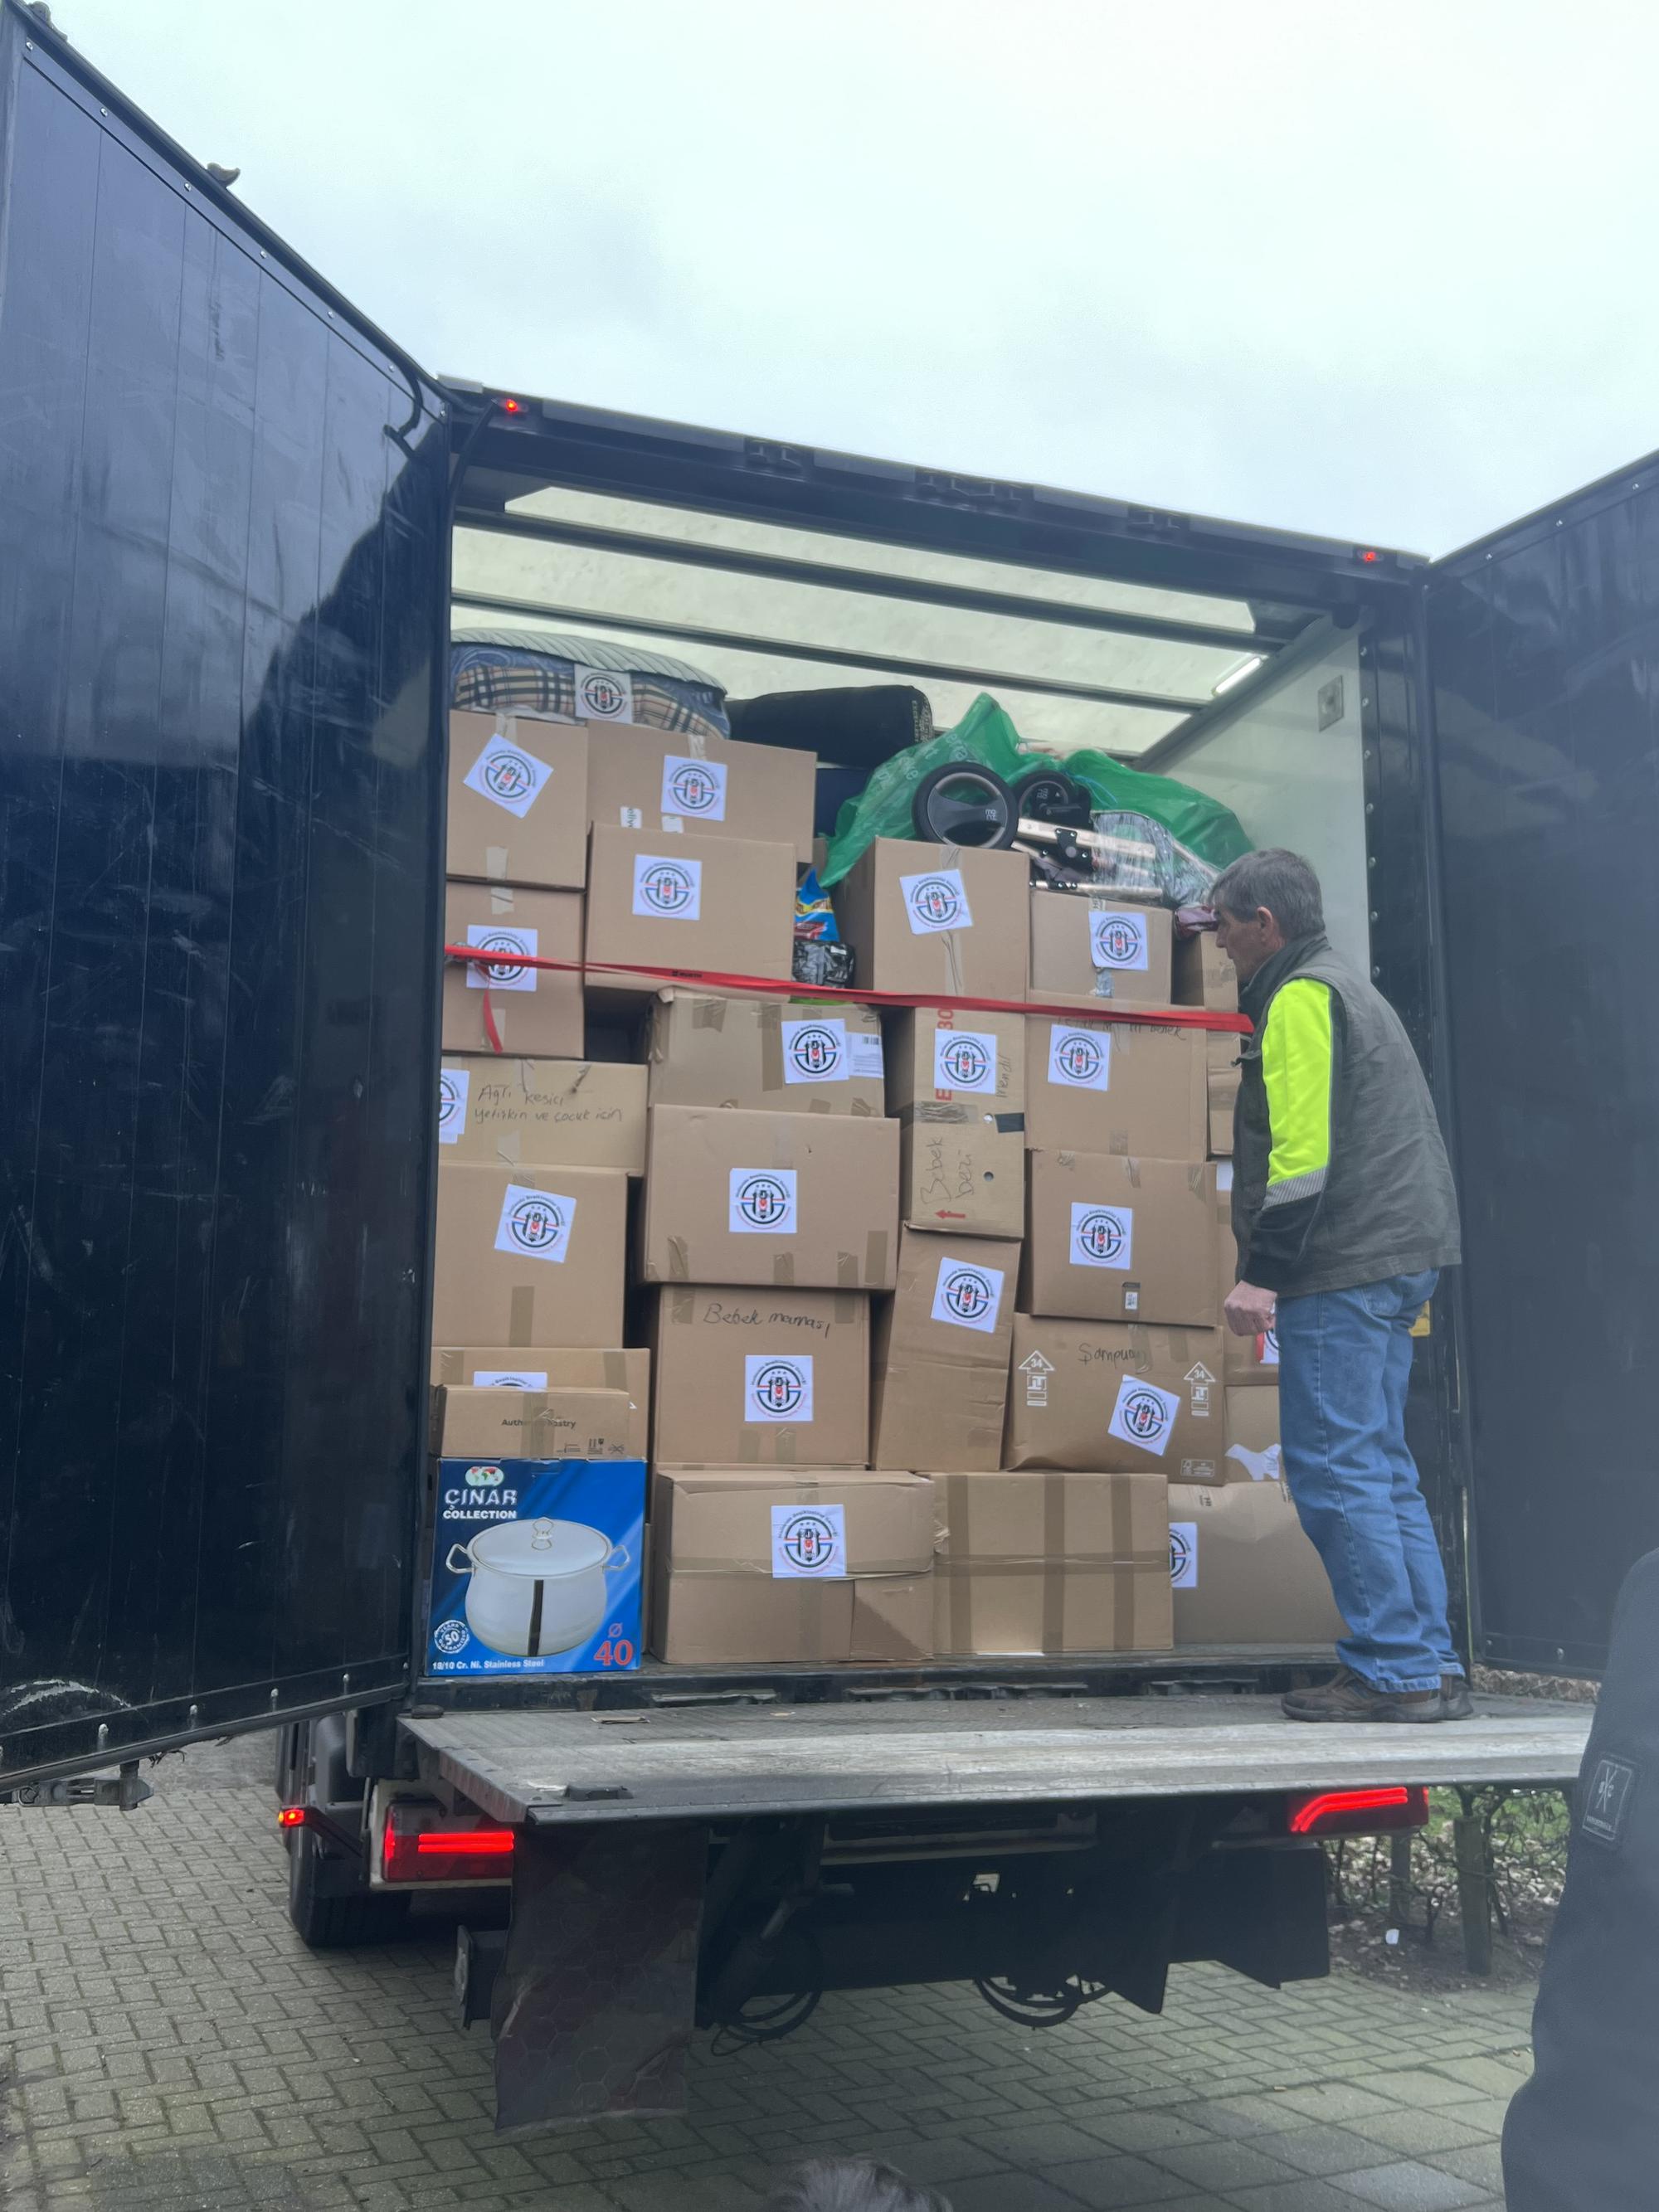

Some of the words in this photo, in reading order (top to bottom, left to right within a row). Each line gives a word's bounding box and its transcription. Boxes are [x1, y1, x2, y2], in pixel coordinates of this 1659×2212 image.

[703, 1302, 764, 1325] Bebek
[442, 1510, 518, 1519] COLLECTION
[444, 1631, 460, 1646] 50
[593, 1639, 633, 1666] 40
[484, 1660, 522, 1669] Stainless
[523, 1658, 544, 1667] Steel
